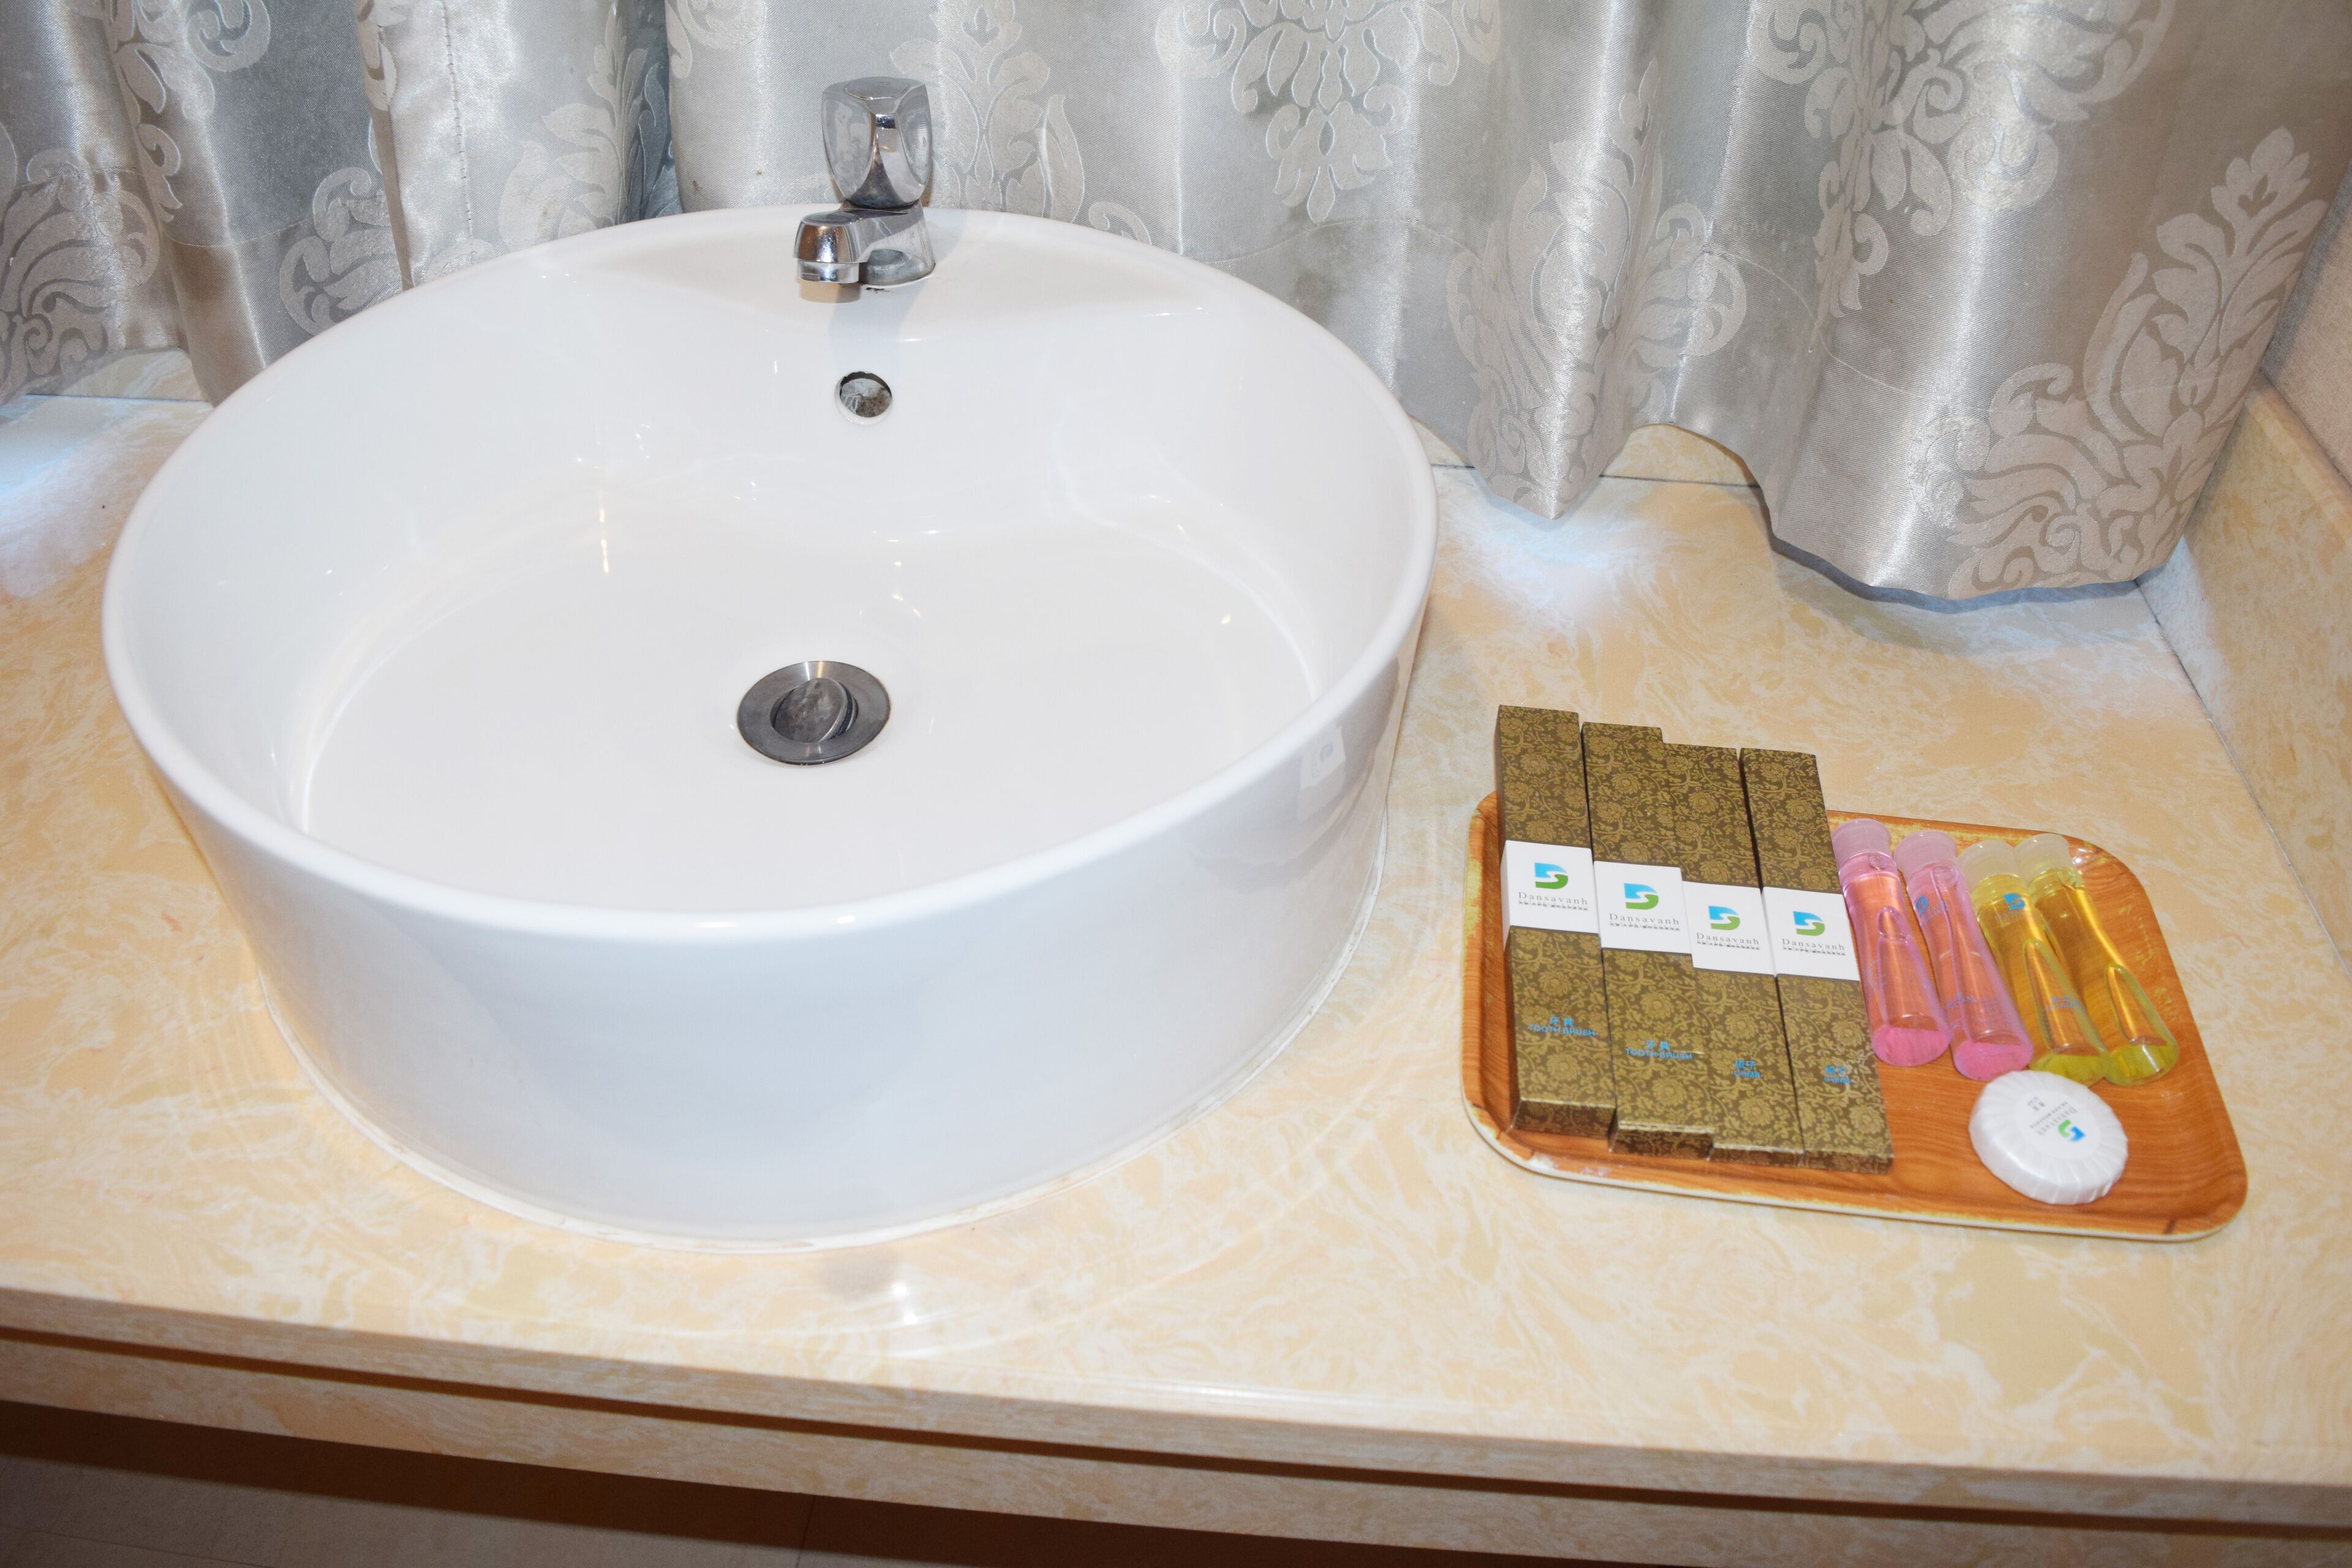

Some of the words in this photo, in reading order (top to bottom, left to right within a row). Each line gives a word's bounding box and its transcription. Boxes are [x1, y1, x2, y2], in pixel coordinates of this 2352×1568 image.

[1518, 891, 1588, 905] Dansavanh
[1610, 913, 1680, 925] Dansavanh
[1696, 932, 1760, 945] Dansavanh
[1782, 938, 1845, 951] Dansavanh
[1529, 1023, 1561, 1033] TOOTH
[1562, 1027, 1596, 1036] BRUSH
[1625, 1048, 1657, 1057] TOOTH
[1659, 1050, 1692, 1060] BRUSH
[1733, 1069, 1761, 1079] COMB
